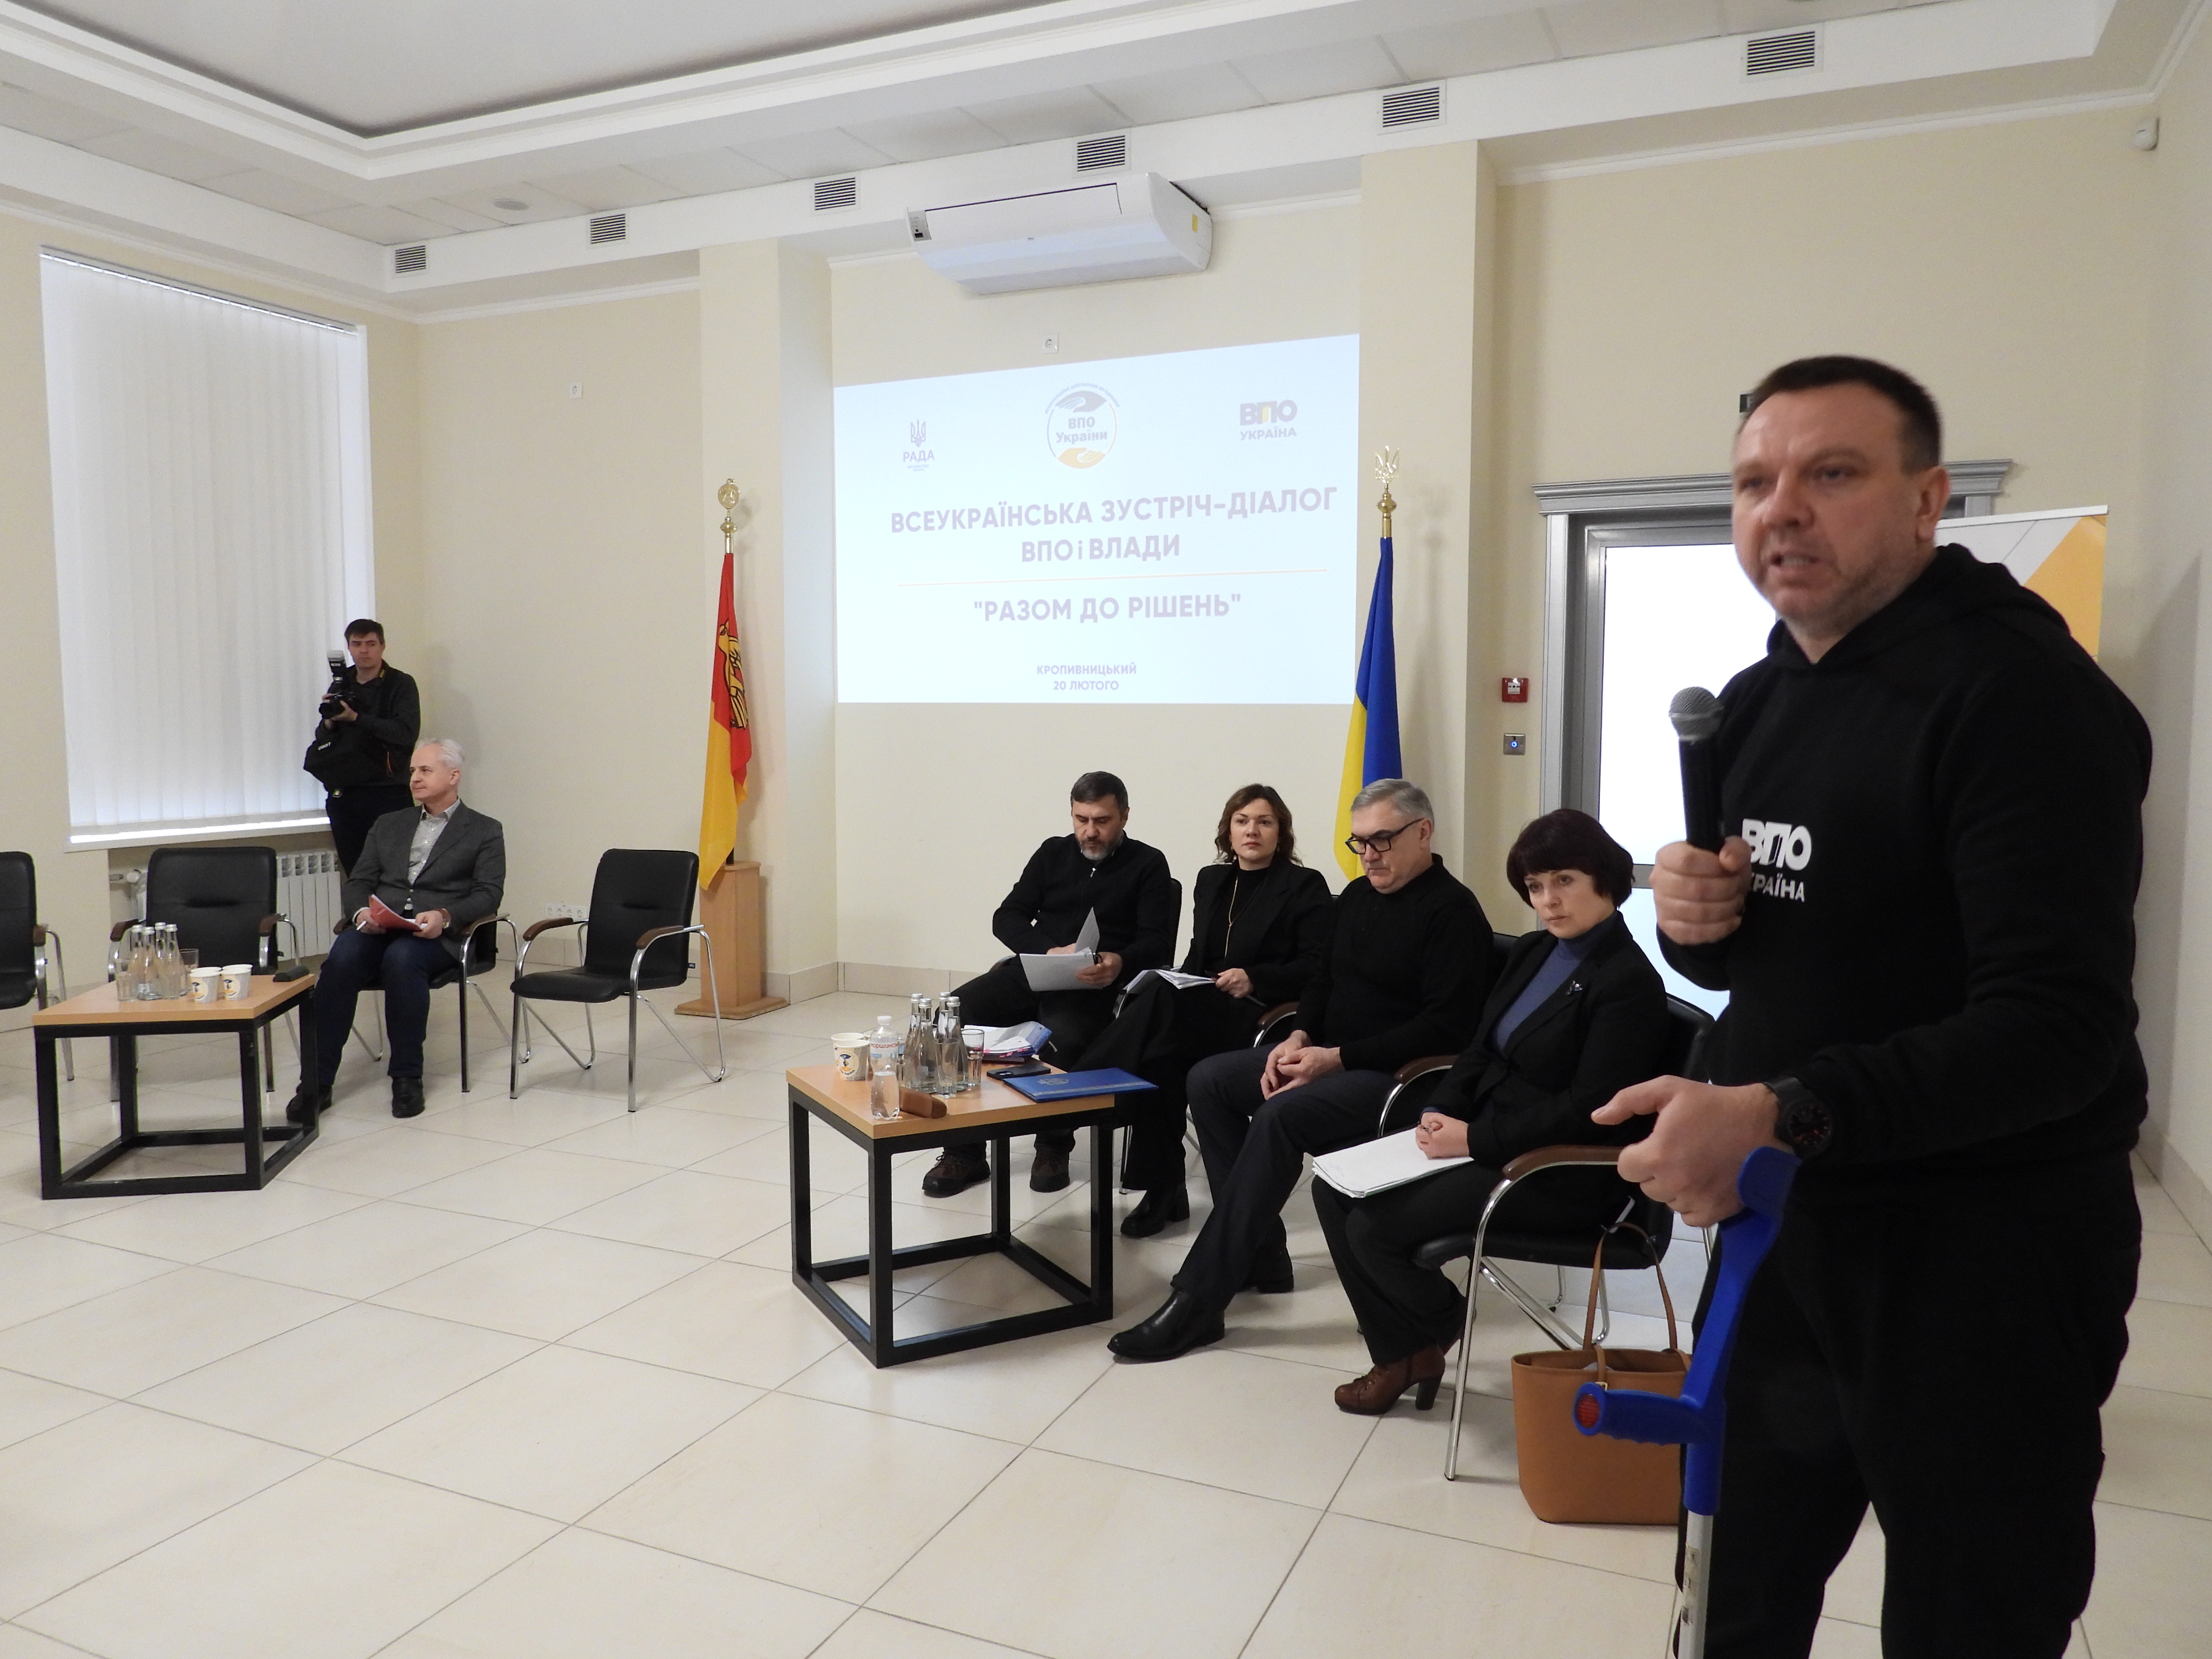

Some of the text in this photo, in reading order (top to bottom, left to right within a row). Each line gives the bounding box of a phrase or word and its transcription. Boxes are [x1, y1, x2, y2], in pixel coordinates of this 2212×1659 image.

[1068, 416, 1095, 429] ВПО
[1240, 399, 1298, 426] ВПО
[1056, 430, 1108, 445] України
[1240, 426, 1297, 441] УКРАЇНА
[903, 449, 935, 463] РАДА
[890, 486, 1337, 533] ВСЕУКРАЇНСЬКА ЗУСТРІЧ-ДІАЛОГ
[1022, 539, 1073, 563] ВПО
[1089, 534, 1180, 562] ВЛАДИ
[974, 593, 1241, 624] "РАЗОМ ДО РІШЕНЬ"
[1037, 661, 1137, 676] КРОПИВНИЦЬКИЙ
[1053, 680, 1119, 691] 20 ЛЮТОГО
[1742, 818, 1812, 871] ВПО
[1752, 872, 1805, 902] РАЇНА
